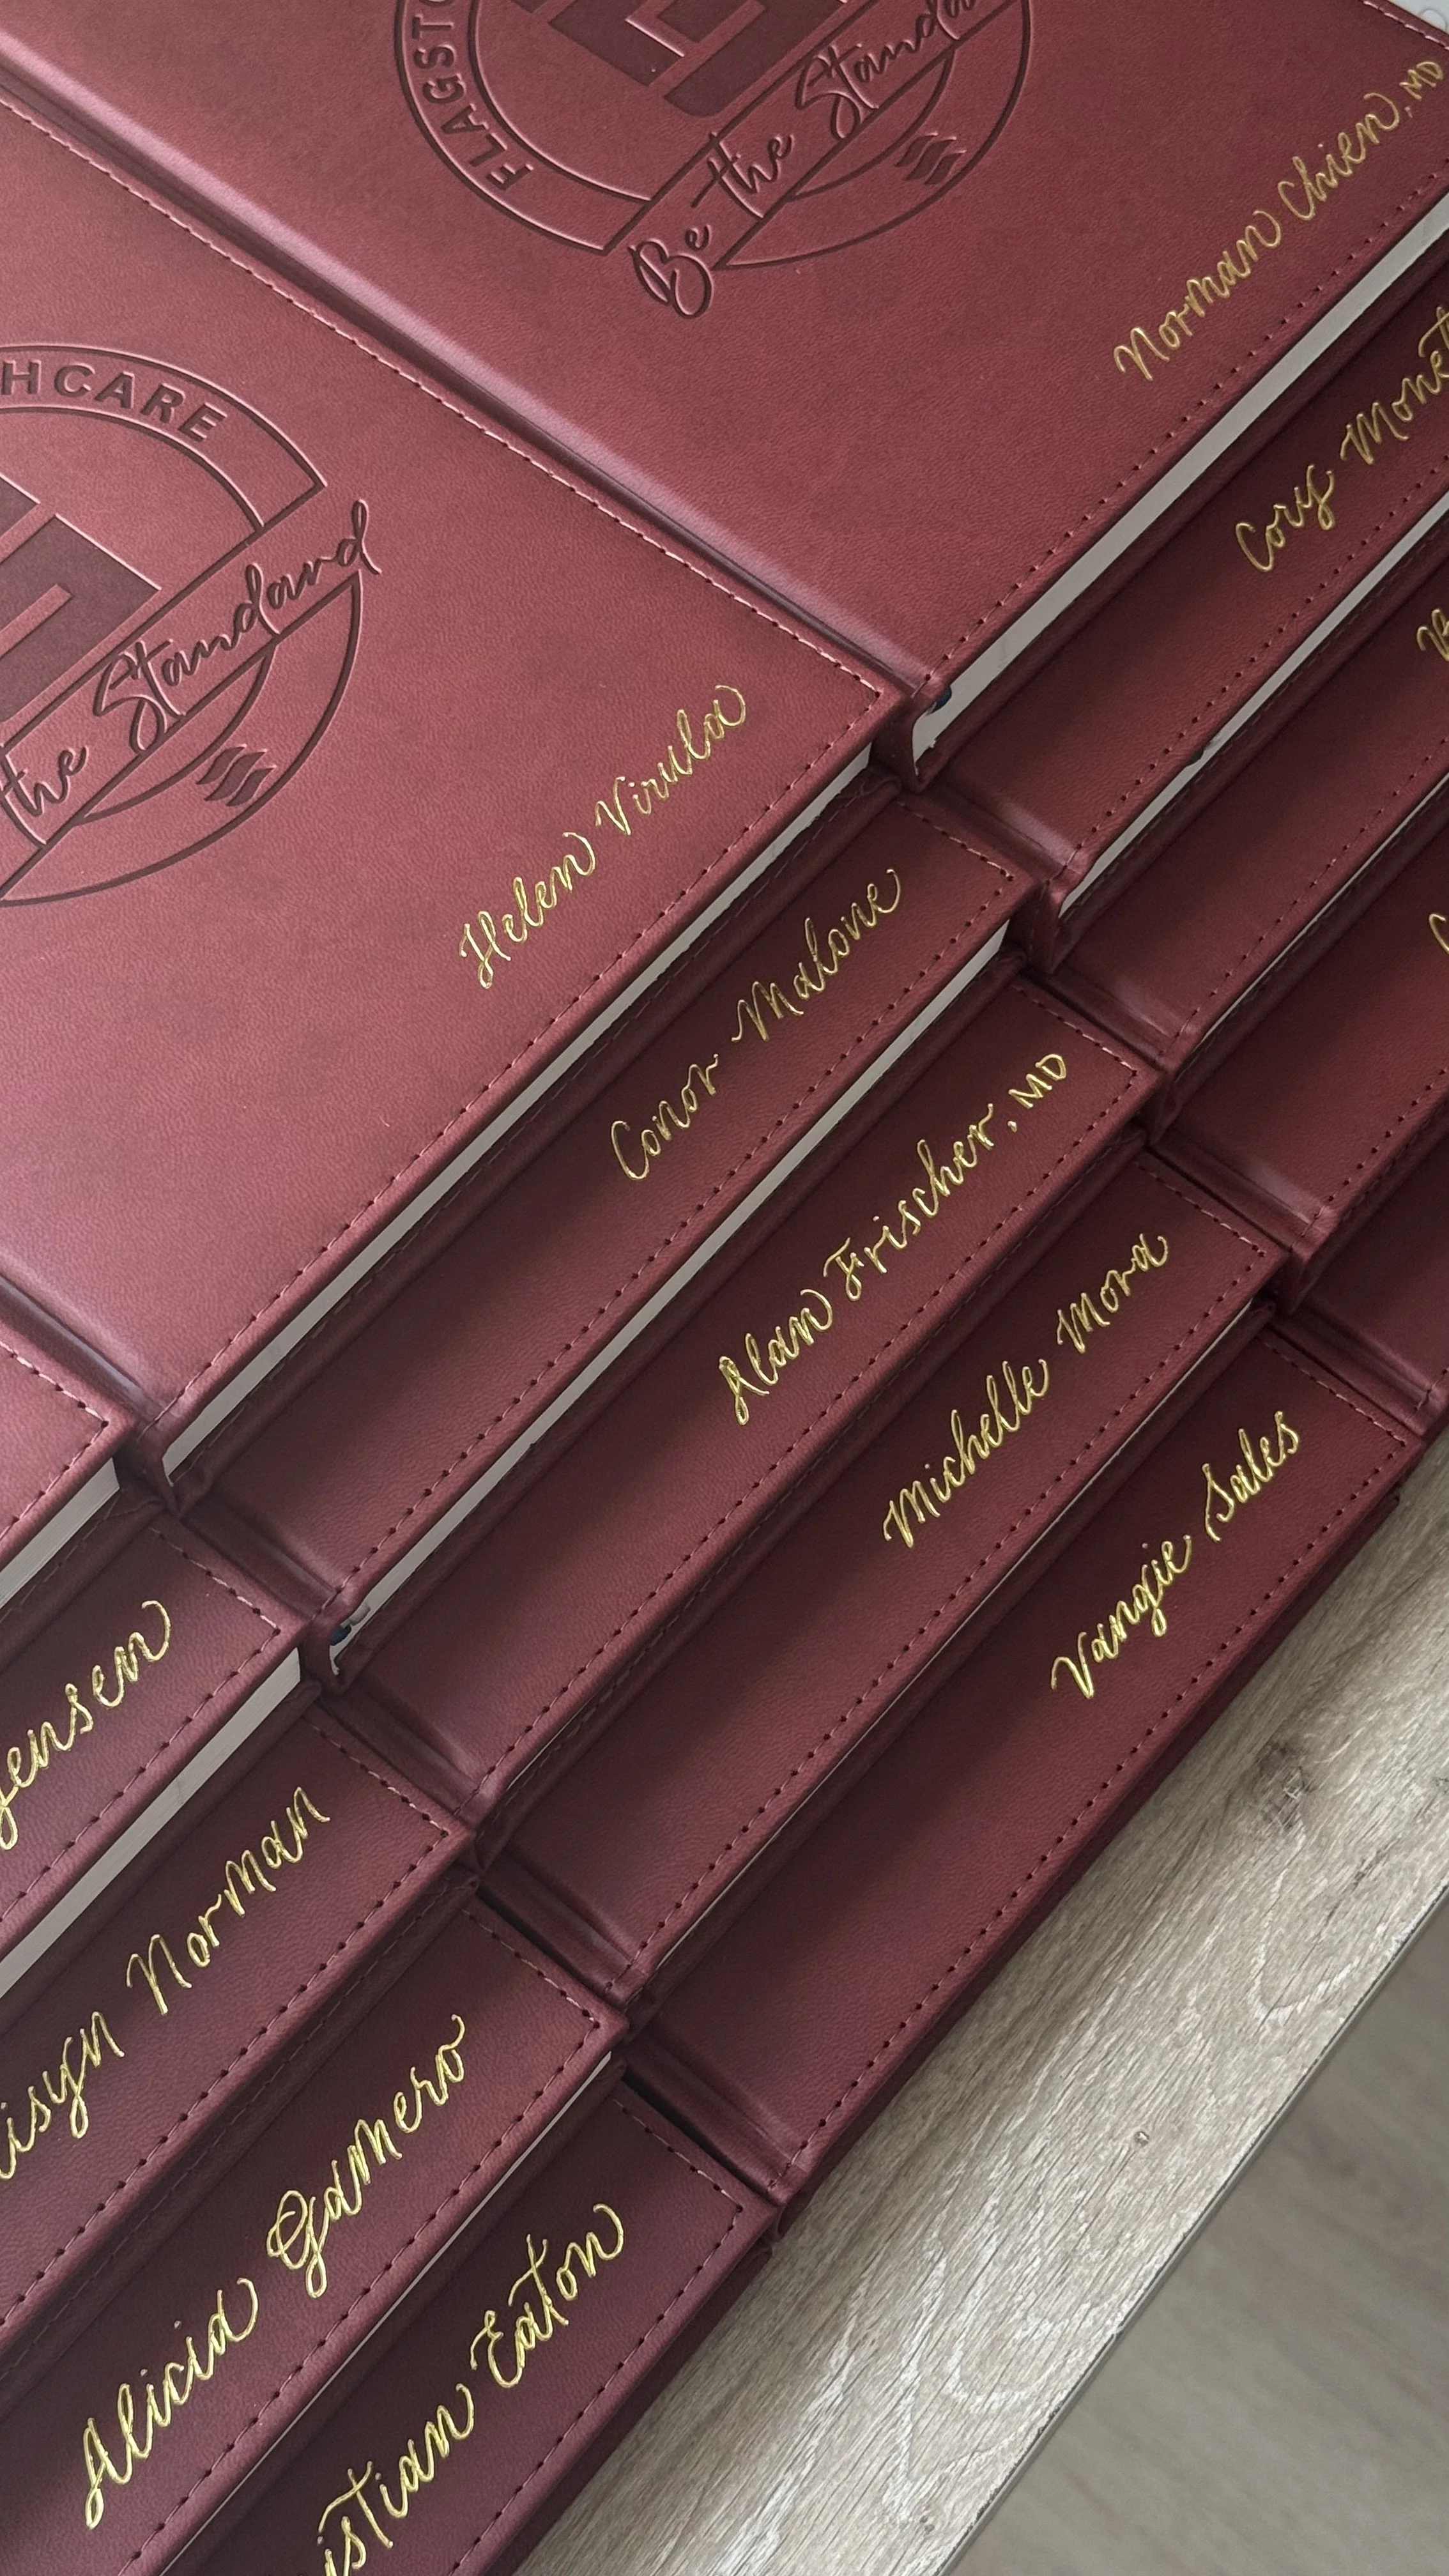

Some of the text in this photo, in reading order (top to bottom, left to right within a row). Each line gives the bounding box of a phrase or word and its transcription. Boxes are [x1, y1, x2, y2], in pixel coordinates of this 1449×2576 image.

[412, 0, 534, 190] FLAGST
[627, 224, 714, 319] Be
[691, 131, 795, 218] the
[1114, 210, 1282, 381] Norman
[1399, 61, 1443, 100] MD
[1, 359, 228, 443] HCARE
[1235, 464, 1336, 572] Cory
[92, 498, 383, 755] Standard
[459, 684, 746, 989] Helen Virula
[610, 868, 901, 1181] Conor Malone
[717, 1288, 834, 1427] Alan
[1008, 1054, 1068, 1110] MD
[882, 1233, 1169, 1549] Michelle Mora
[1050, 1410, 1301, 1699] Vangie Sales
[82, 2012, 466, 2531] Alicia Gamero
[468, 2202, 625, 2390] Eaton
